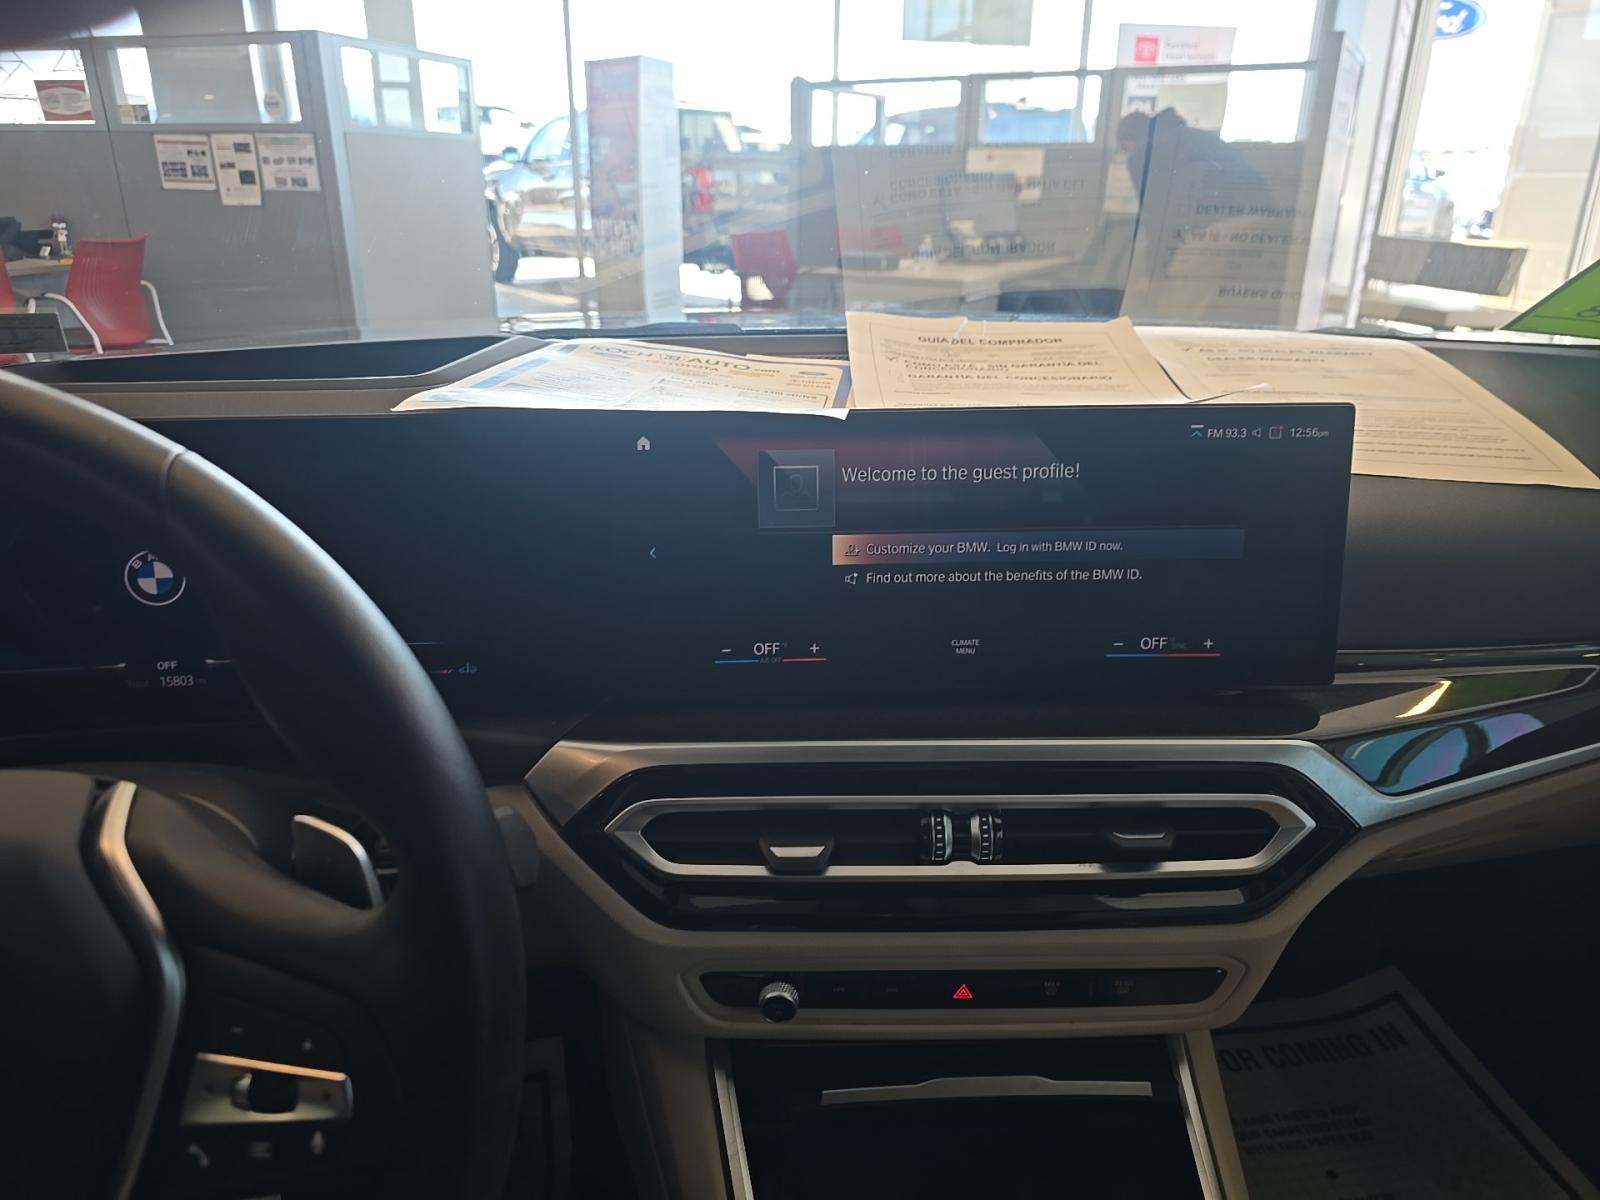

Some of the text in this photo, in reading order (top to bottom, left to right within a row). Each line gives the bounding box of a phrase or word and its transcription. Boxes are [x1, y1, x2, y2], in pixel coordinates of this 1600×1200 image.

[1207, 427, 1247, 440] FM 93.3
[841, 463, 1080, 484] Welcome to the guest profile!
[866, 540, 1123, 558] Customize your BMW. Log in with BMW ID now.
[866, 568, 1143, 584] Find out more about the benefits of the BMW ID.
[753, 642, 781, 656] OFF
[951, 638, 980, 647] CLIMATE
[1140, 637, 1168, 650] OFF
[955, 647, 976, 655] MENU
[157, 660, 178, 671] OFF
[160, 675, 194, 689] 15803
